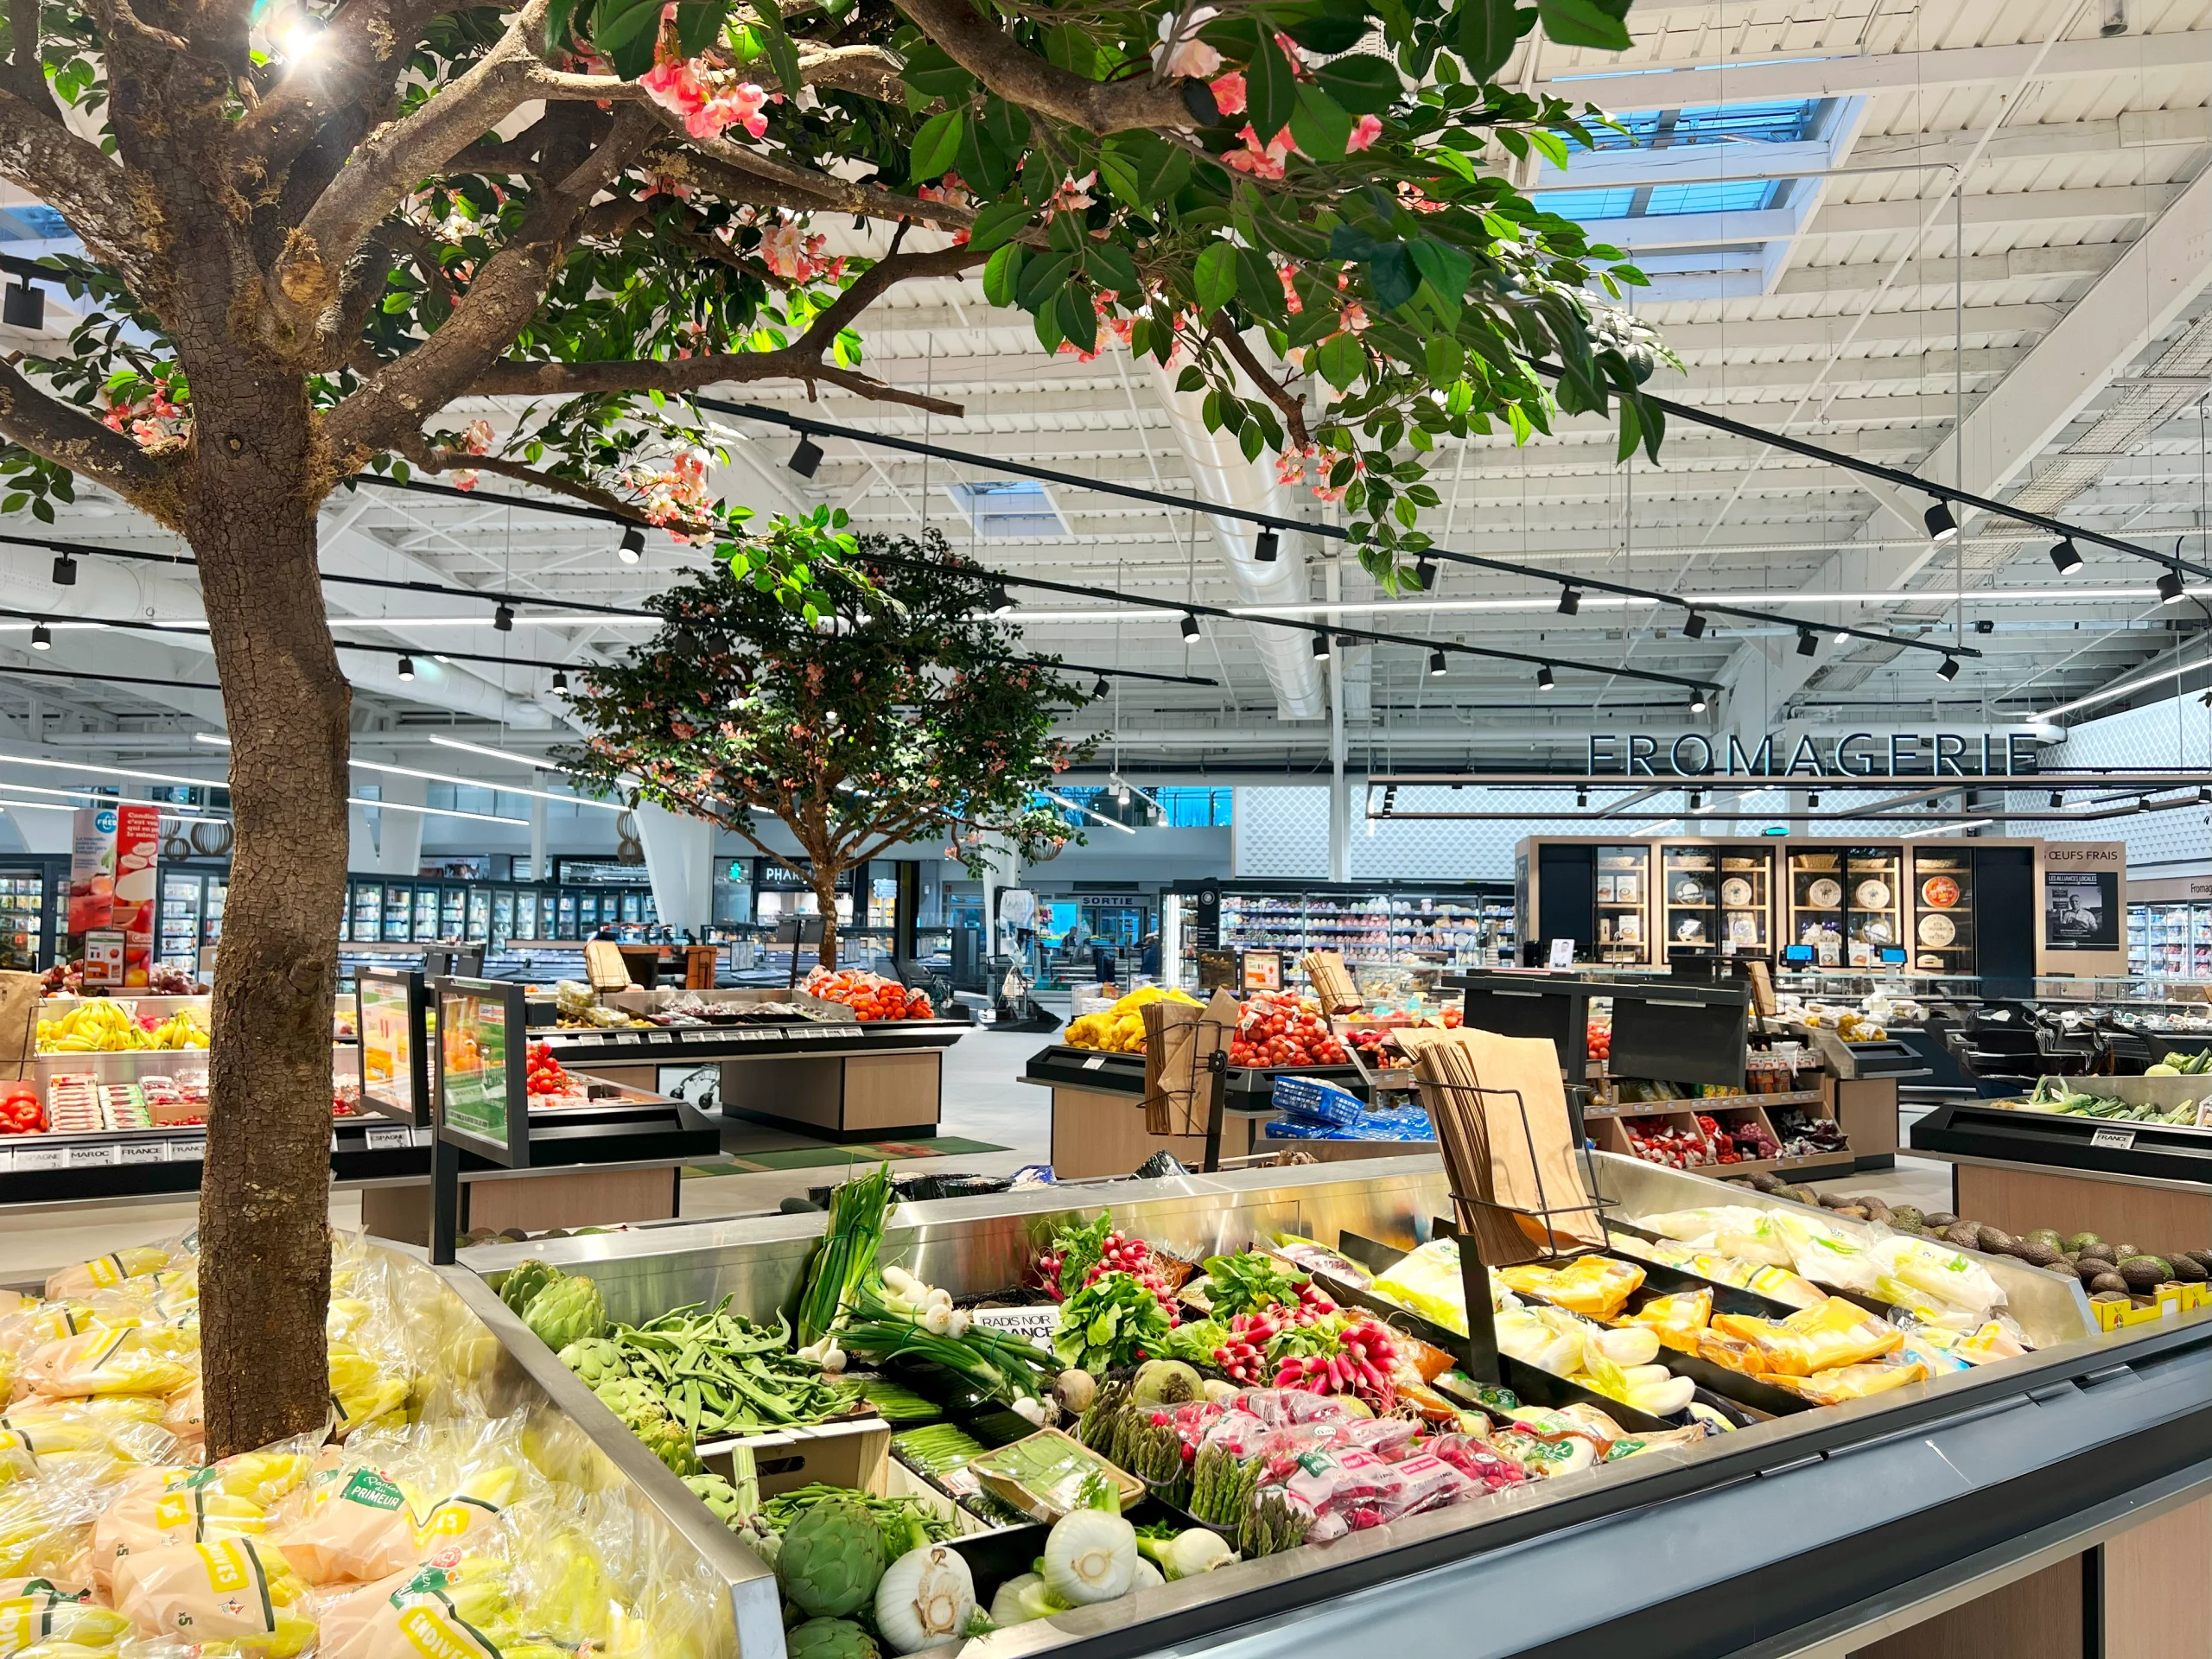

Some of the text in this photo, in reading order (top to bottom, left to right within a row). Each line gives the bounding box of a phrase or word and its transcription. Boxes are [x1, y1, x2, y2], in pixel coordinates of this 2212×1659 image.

[1587, 733, 2037, 777] FROMAGERIE
[2049, 851, 2118, 860] ŒUFS FRAIS
[1083, 896, 1134, 906] SORTIE
[2096, 1133, 2128, 1142] FRANCE
[17, 1153, 61, 1162] ESPAGNE
[71, 1150, 110, 1159] MAROC
[982, 1314, 1052, 1327] RADIS NOIR
[363, 1476, 400, 1493] Panier
[374, 1485, 386, 1494] du
[350, 1484, 400, 1508] PRIMEUR
[178, 1611, 194, 1627] x5
